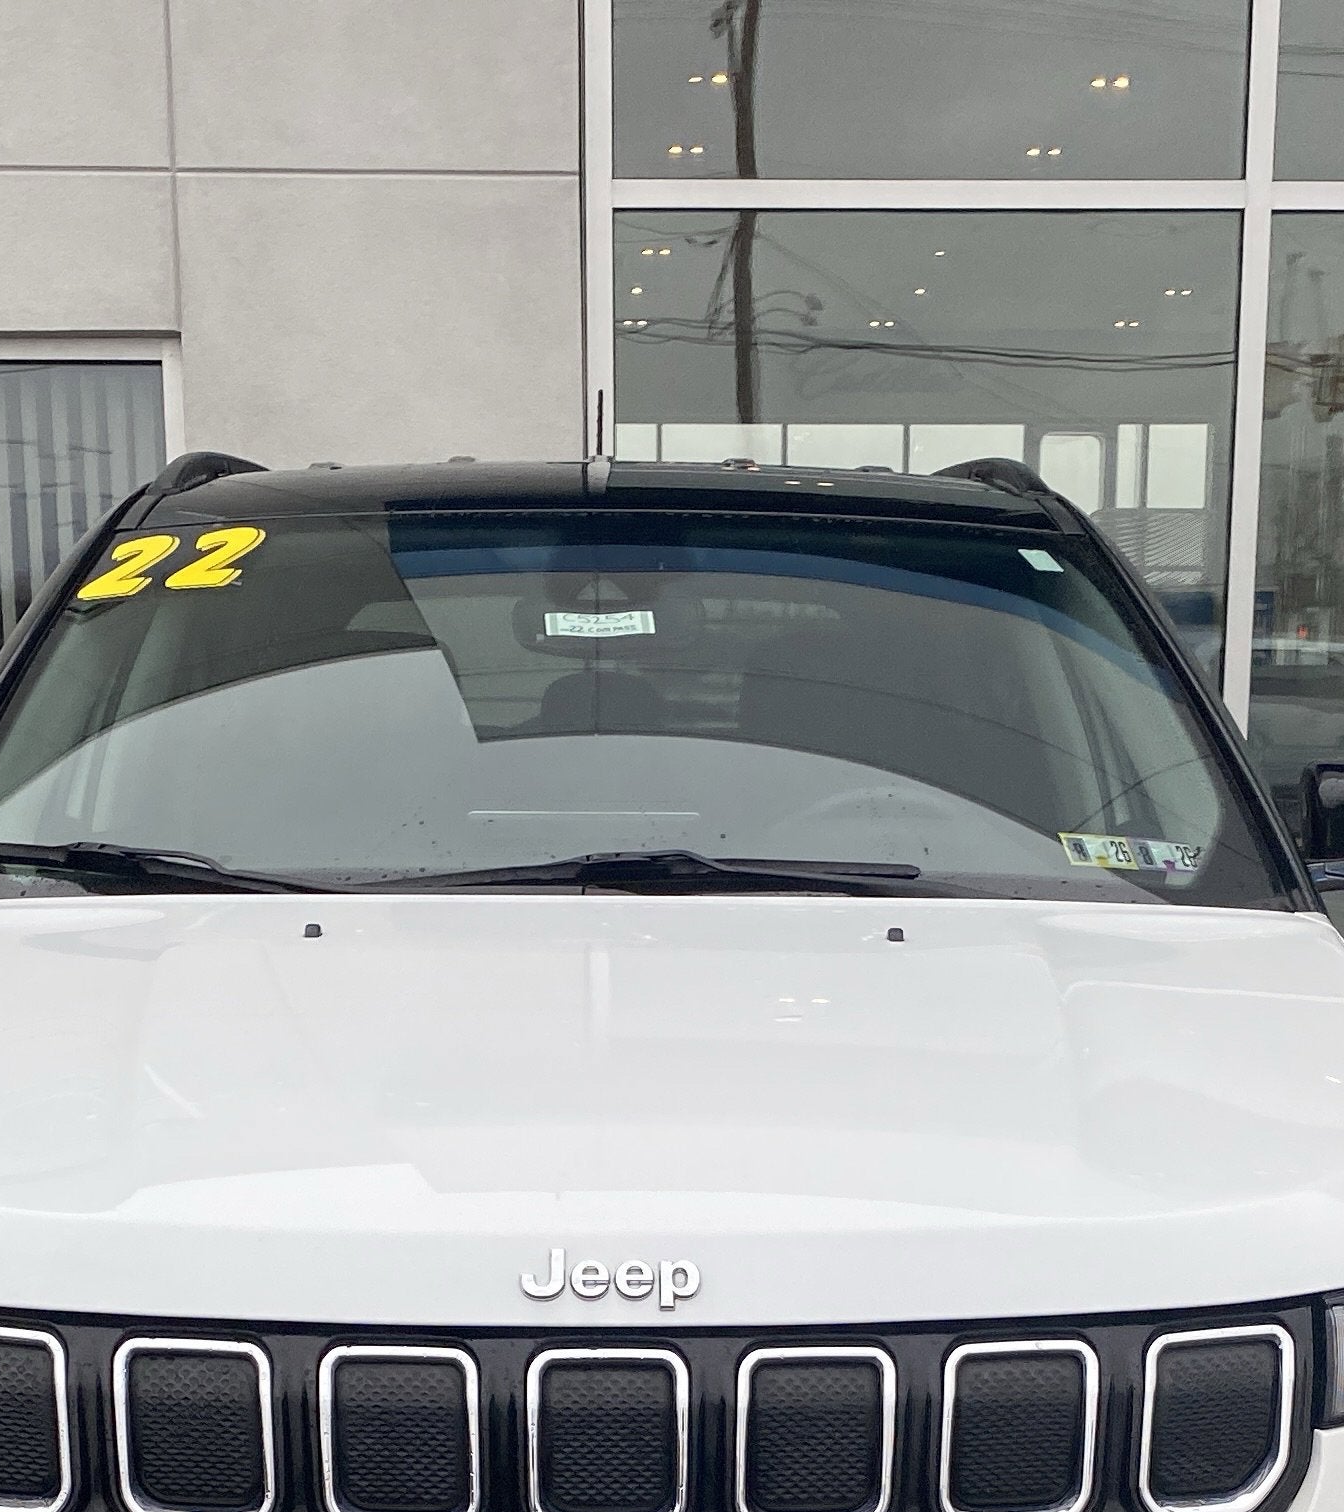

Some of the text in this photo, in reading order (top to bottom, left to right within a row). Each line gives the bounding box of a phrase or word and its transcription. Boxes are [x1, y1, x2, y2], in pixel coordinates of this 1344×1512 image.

[77, 527, 266, 600] 22
[1110, 841, 1132, 863] 26
[520, 1248, 701, 1311] Jeep
